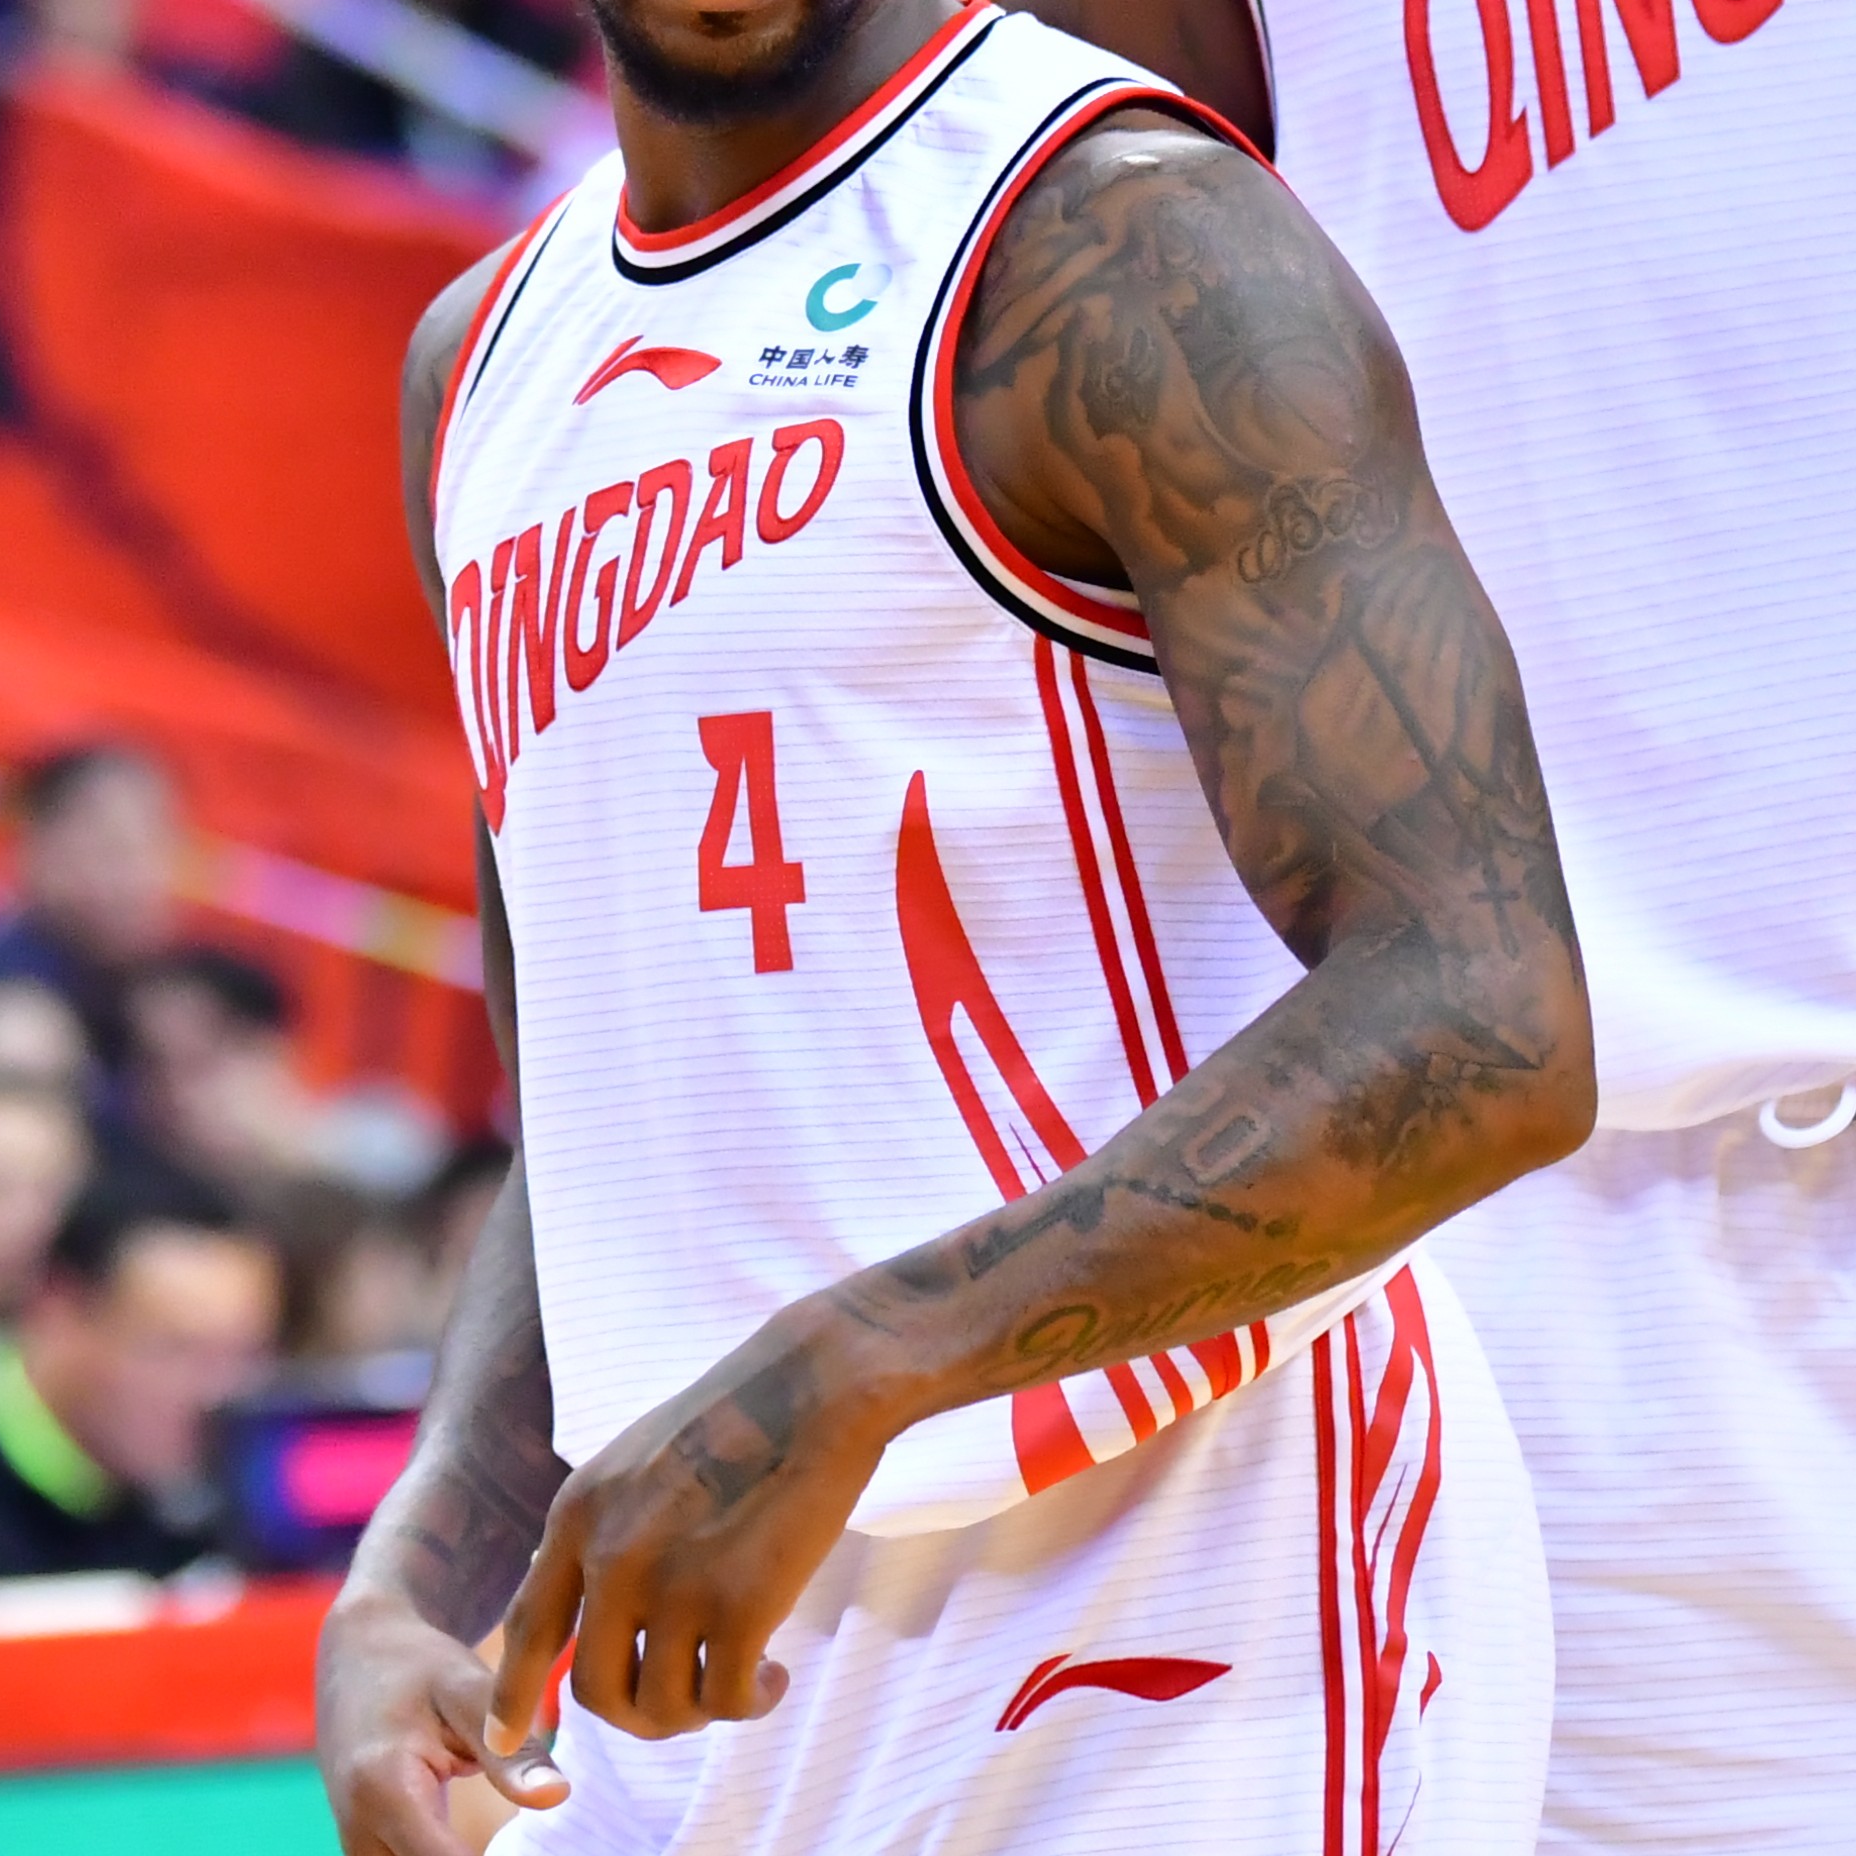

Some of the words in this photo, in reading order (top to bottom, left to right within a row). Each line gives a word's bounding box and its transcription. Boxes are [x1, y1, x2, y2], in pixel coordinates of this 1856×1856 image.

[758, 344, 870, 370] 中国人寿
[748, 373, 810, 388] CHINA
[813, 374, 859, 388] LIFE
[697, 710, 807, 975] 4
